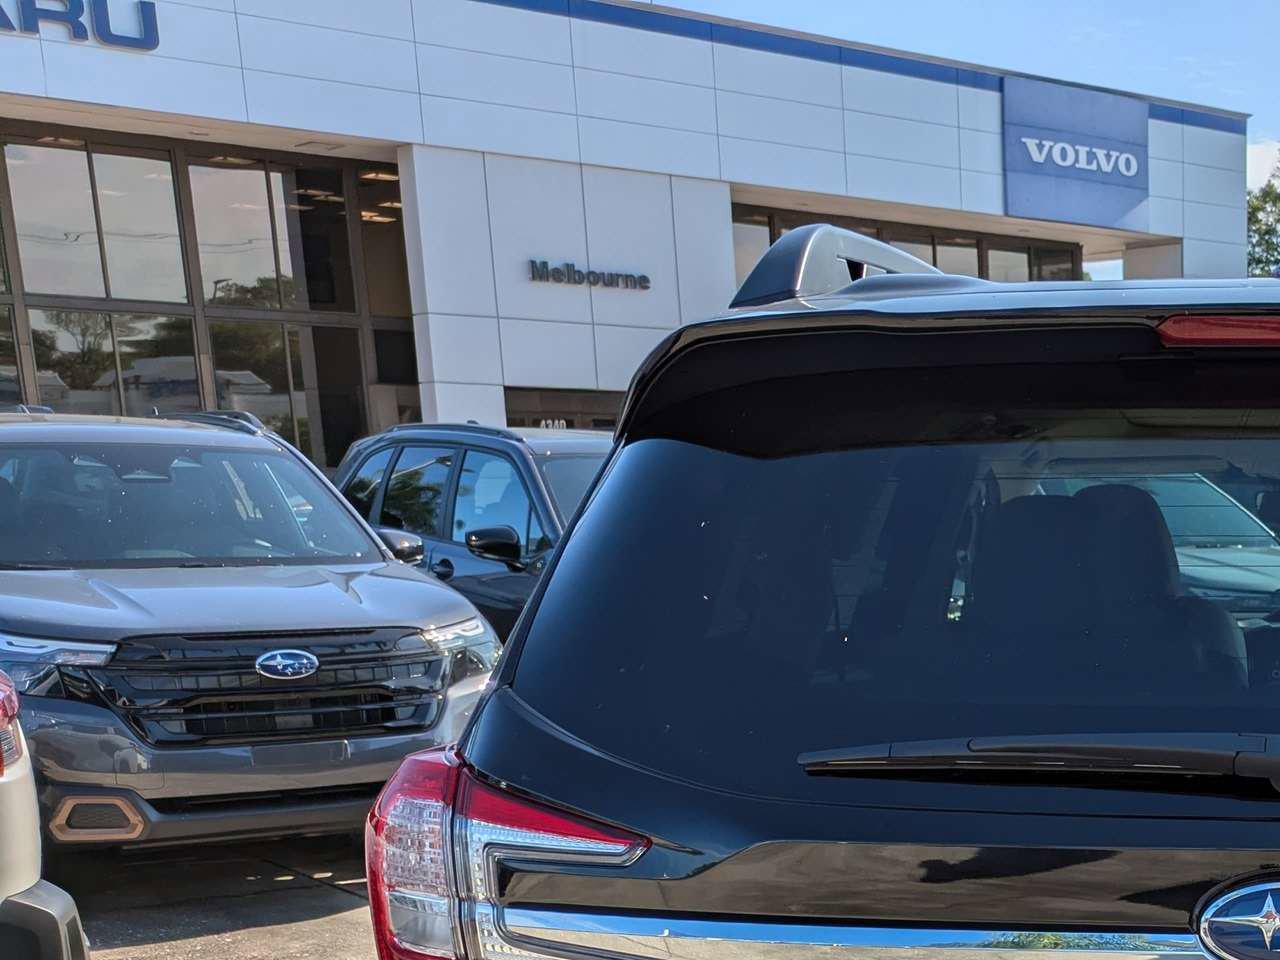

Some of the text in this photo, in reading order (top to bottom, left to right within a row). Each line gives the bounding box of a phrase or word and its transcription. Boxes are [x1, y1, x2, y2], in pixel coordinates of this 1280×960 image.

[0, 0, 160, 52] RU
[1021, 137, 1138, 177] VOLVO
[529, 259, 650, 290] Melbourne
